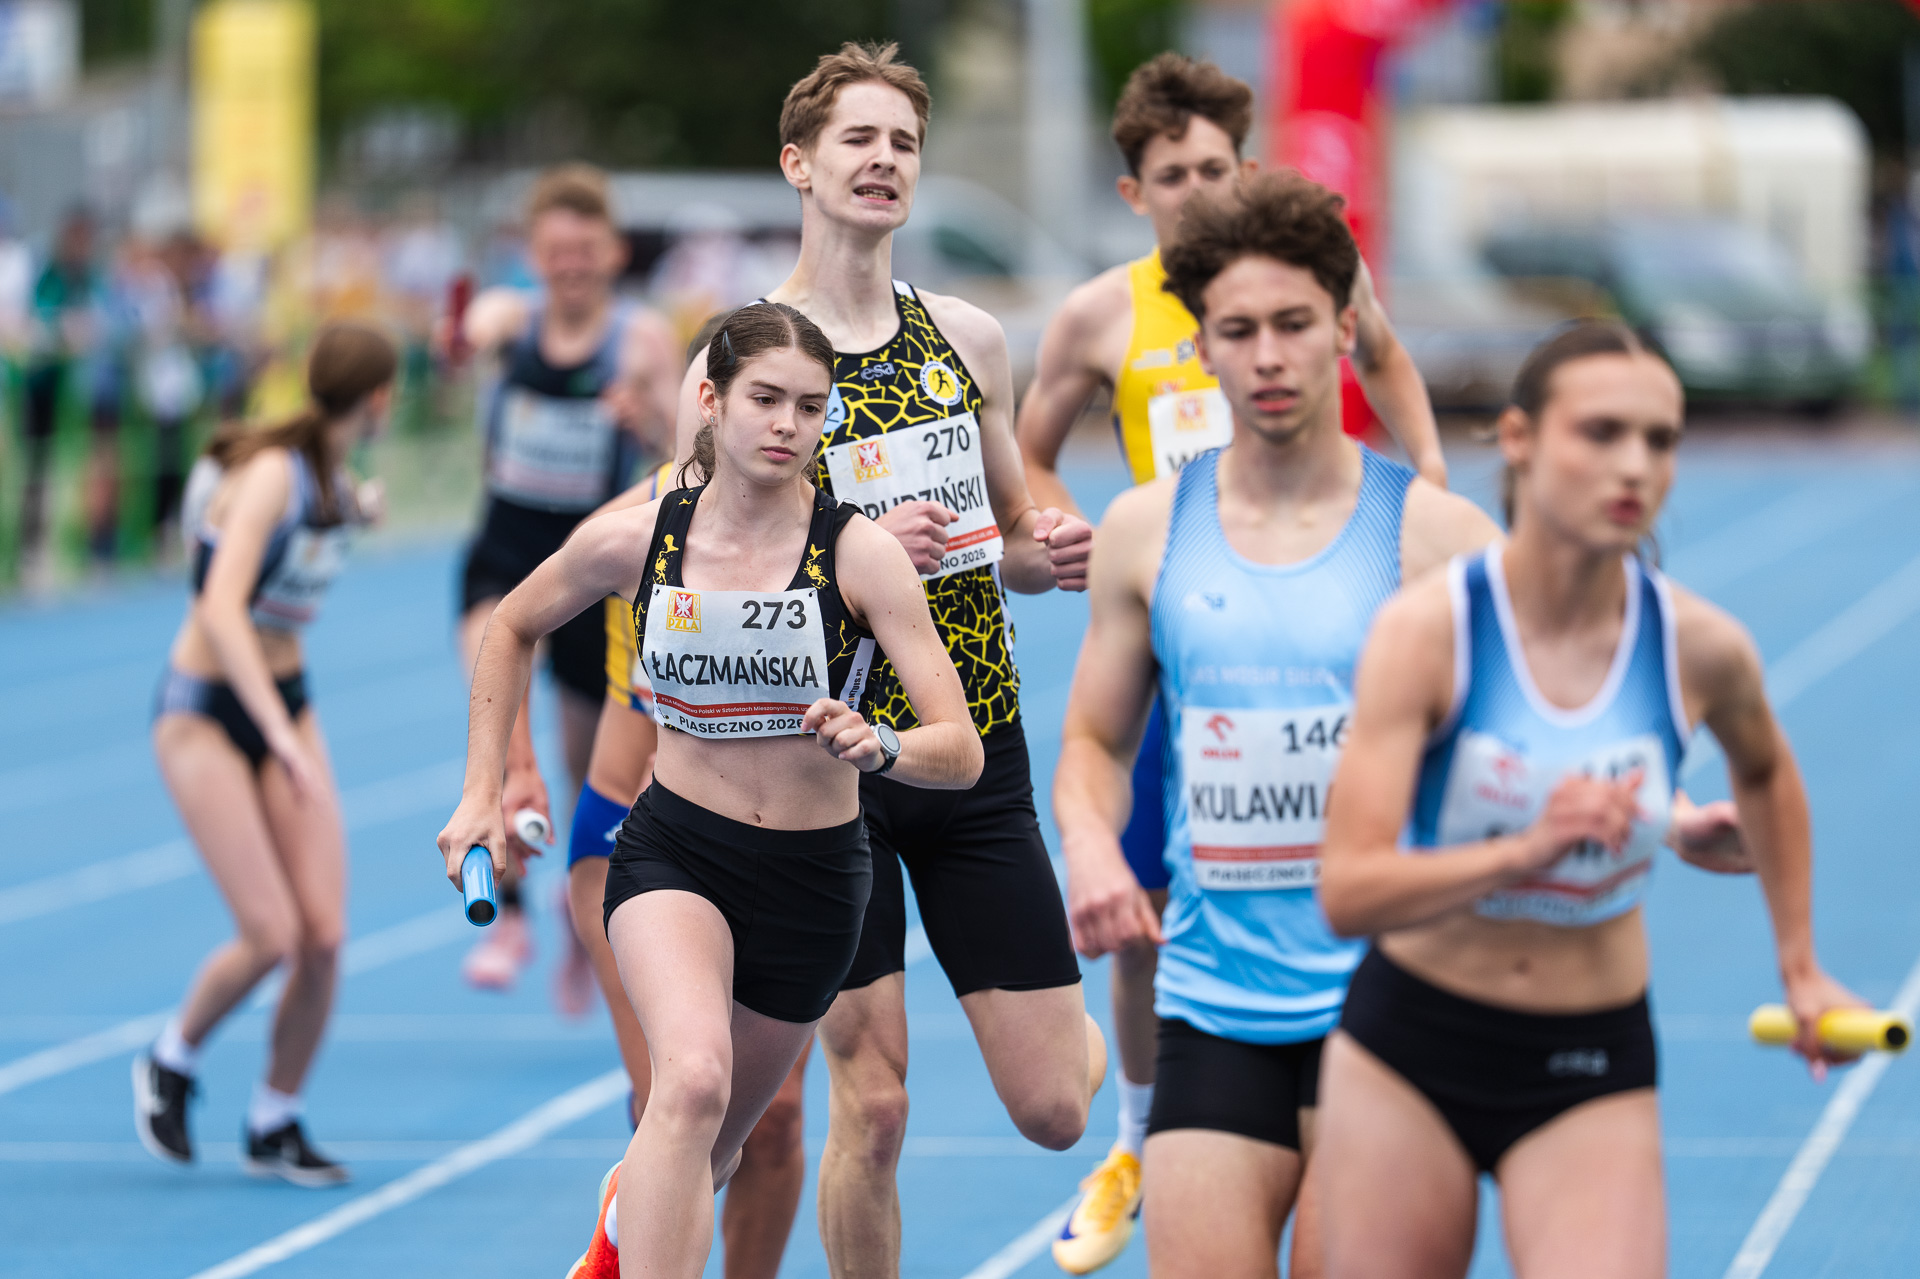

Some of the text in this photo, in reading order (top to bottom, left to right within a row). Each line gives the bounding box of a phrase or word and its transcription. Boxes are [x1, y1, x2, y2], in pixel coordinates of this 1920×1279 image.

[860, 362, 896, 380] esa
[923, 425, 970, 461] 270
[857, 465, 889, 481] PZLA
[961, 548, 986, 565] 2026
[668, 618, 699, 631] PZLA
[742, 600, 806, 630] 273
[651, 649, 819, 688] ŁACZMAŃSKA
[679, 715, 803, 733] PIASECZNO 2026
[1282, 716, 1347, 753] 146
[1190, 783, 1331, 821] KULAWI
